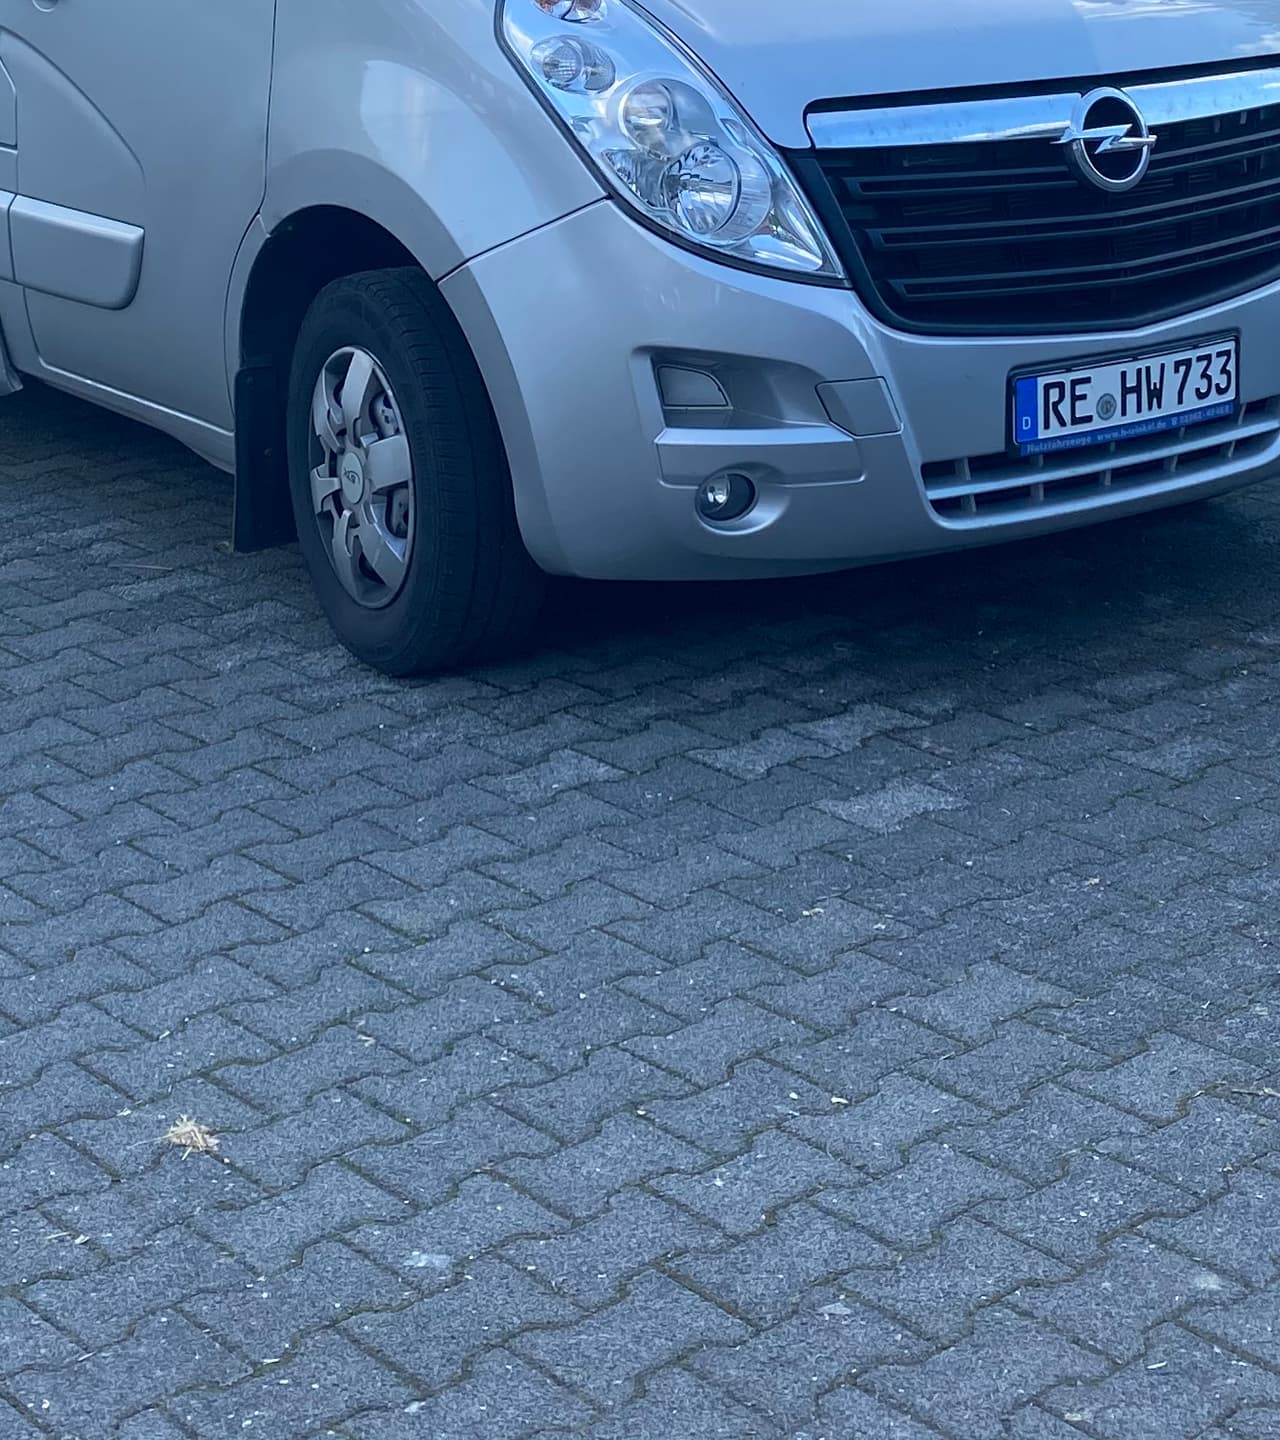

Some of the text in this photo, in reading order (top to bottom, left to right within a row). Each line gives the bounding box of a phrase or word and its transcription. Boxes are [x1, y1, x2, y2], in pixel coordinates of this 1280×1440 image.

[1043, 349, 1232, 430] RE HW 733
[1022, 416, 1032, 430] D
